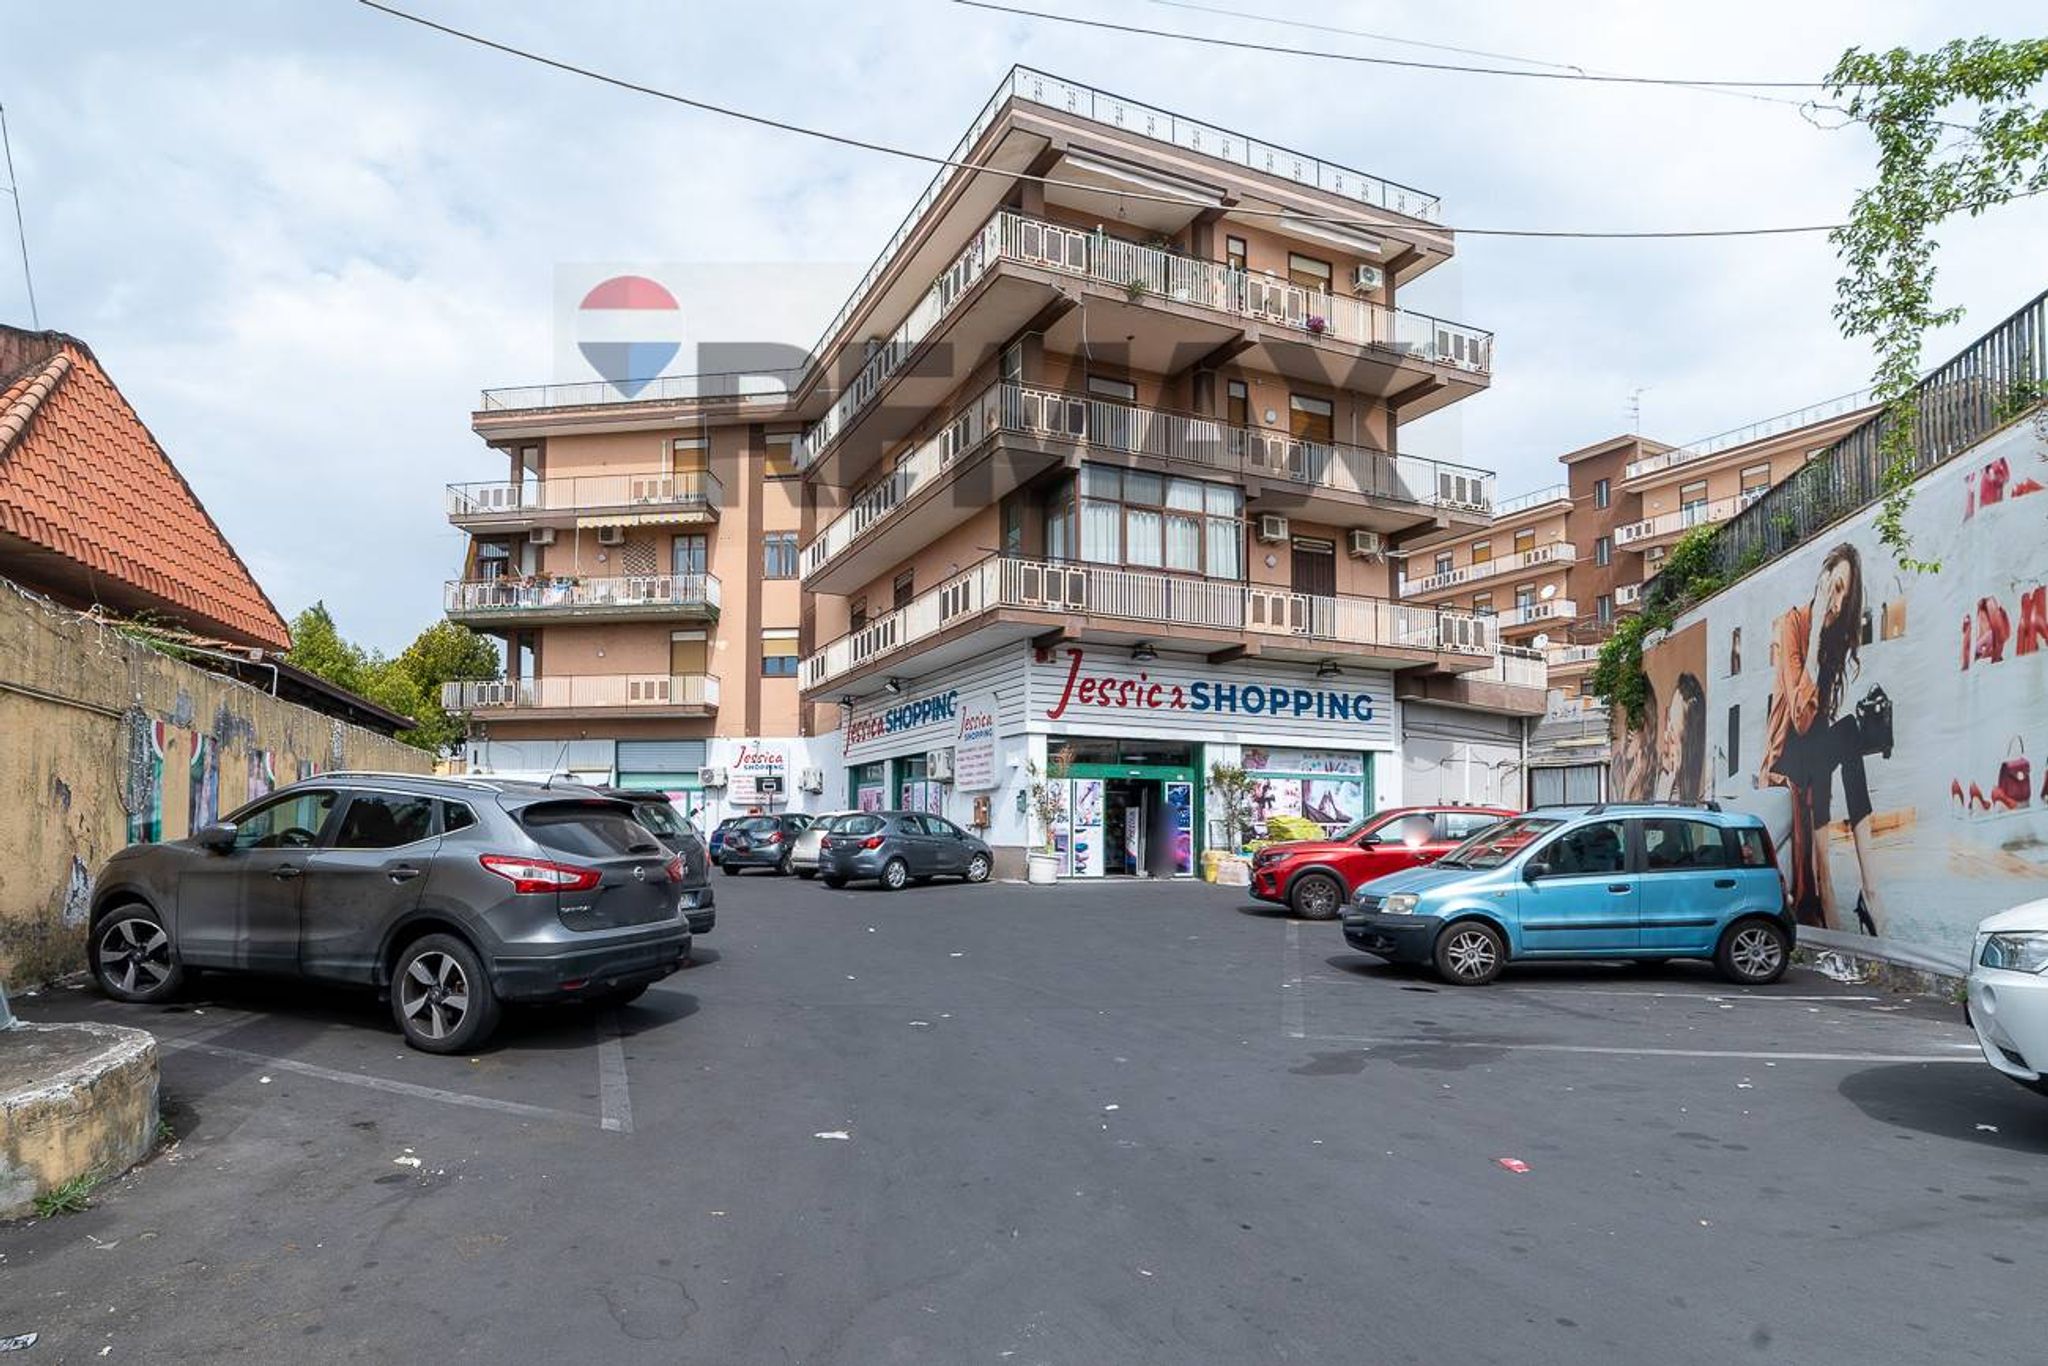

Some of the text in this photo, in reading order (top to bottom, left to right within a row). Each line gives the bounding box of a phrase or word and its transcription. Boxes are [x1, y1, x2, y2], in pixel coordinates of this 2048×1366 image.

[884, 690, 958, 733] SHOPPING
[1190, 682, 1374, 721] SHOPPING
[958, 705, 992, 739] Jessica
[733, 745, 783, 768] Jessica
